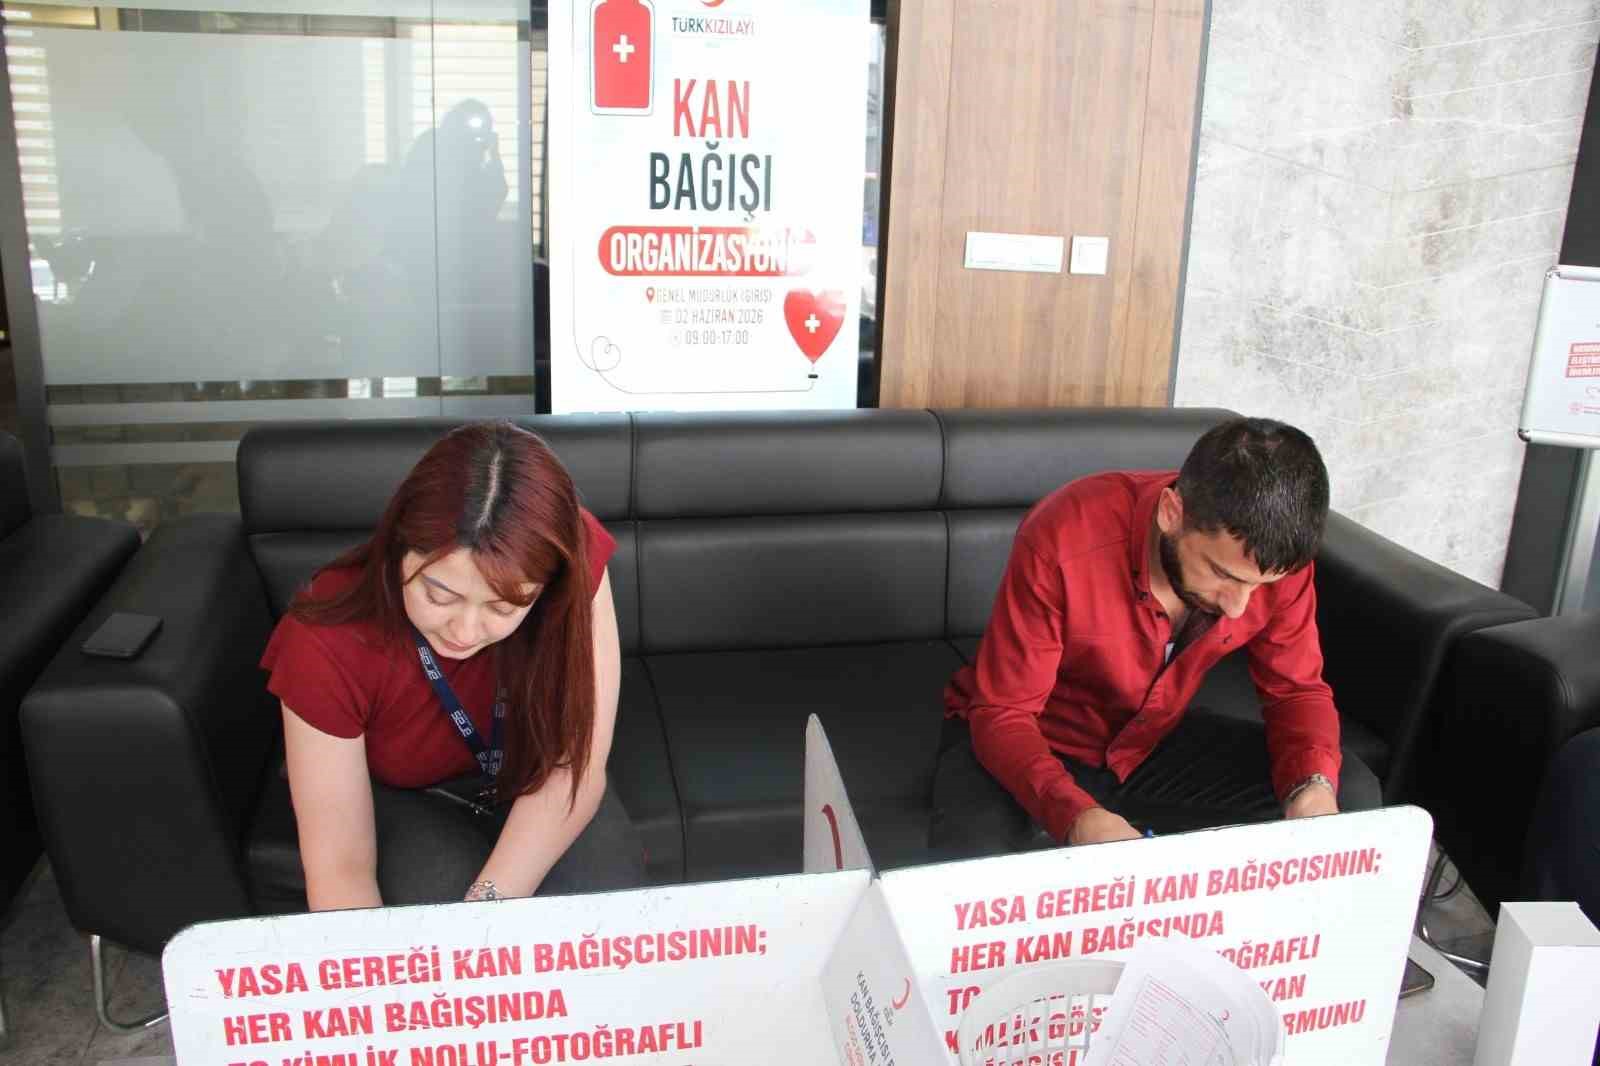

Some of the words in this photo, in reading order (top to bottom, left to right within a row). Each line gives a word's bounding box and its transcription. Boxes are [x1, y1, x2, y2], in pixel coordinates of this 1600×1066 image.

[672, 78, 750, 138] KAN
[649, 140, 772, 222] BAĞIŞI
[657, 287, 685, 304] GENEL
[953, 895, 1027, 931] YASA
[1036, 874, 1136, 920] GEREĞİ
[1143, 872, 1199, 905] KAN
[1206, 847, 1382, 897] BAĞIŞCISININ;
[215, 962, 309, 999] YASA
[318, 944, 442, 991] GEREĞİ
[453, 945, 522, 980] KAN
[533, 924, 768, 970] BAĞIŞCISININ;
[950, 940, 1007, 974] HER
[1015, 930, 1073, 965] KAN
[856, 970, 870, 1000] KAN
[223, 1012, 293, 1046] HER
[303, 1005, 374, 1039] KAN
[384, 988, 569, 1032] BAĞIŞINDA
